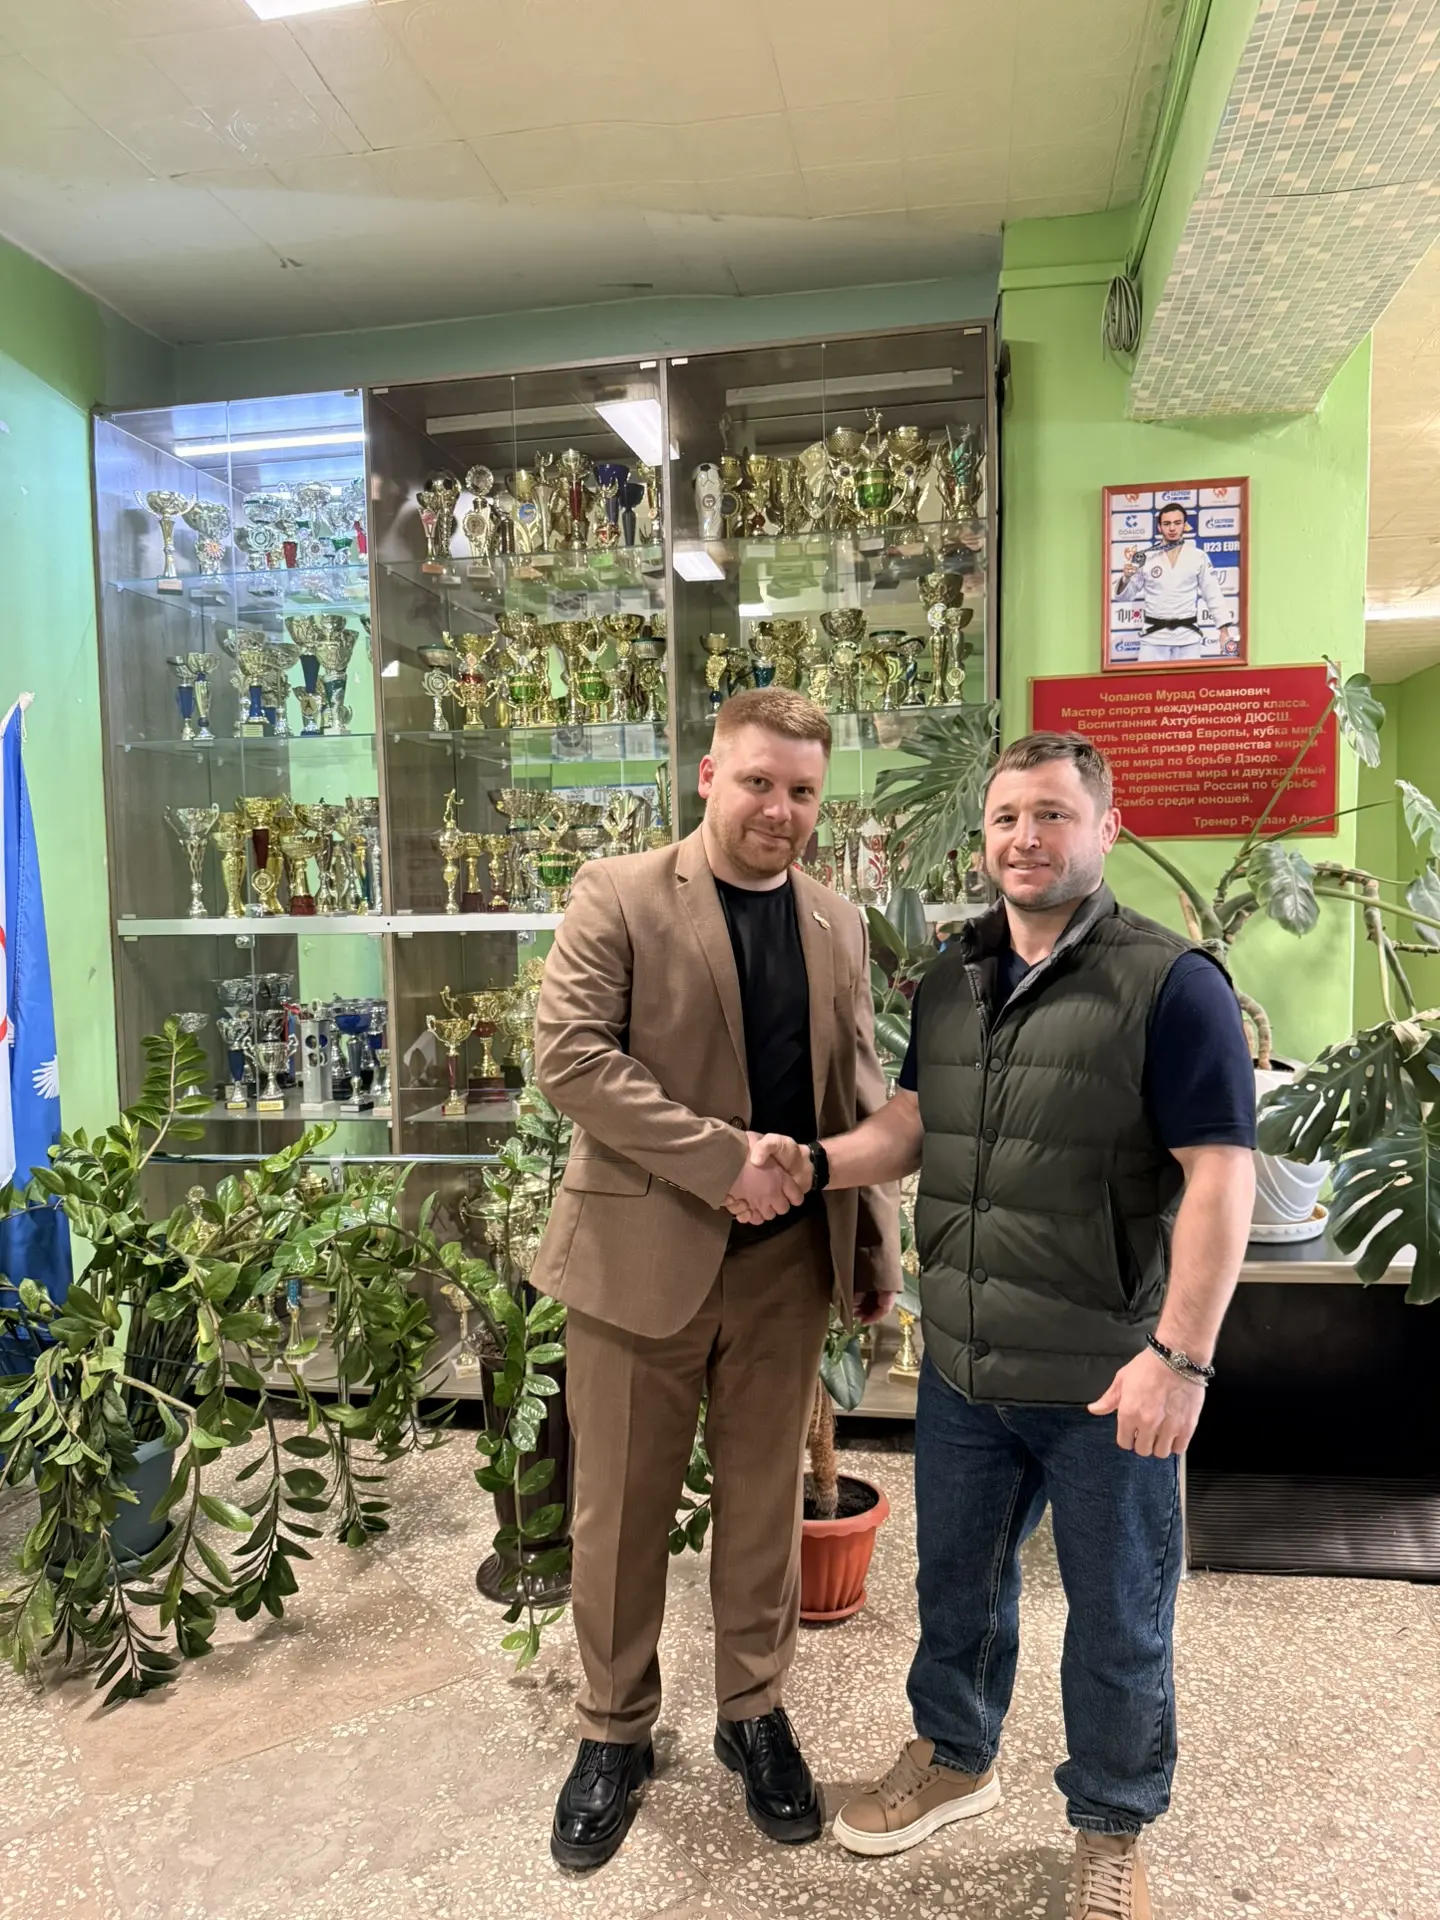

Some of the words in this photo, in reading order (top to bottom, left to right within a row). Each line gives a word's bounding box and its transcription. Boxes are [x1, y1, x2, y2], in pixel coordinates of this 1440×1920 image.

[1100, 692, 1153, 702] Чопанов
[1156, 689, 1196, 701] Мурад
[1199, 687, 1270, 698] Османович
[1061, 708, 1105, 718] Мастер
[1109, 705, 1151, 716] спорта
[1154, 702, 1260, 714] международного
[1264, 699, 1309, 710] класса.
[1078, 719, 1157, 730] Воспитанник
[1160, 714, 1242, 728] Ахтубинской
[1121, 731, 1193, 743] первенства
[1196, 728, 1250, 739] Европы,
[1253, 725, 1288, 738] кубка
[1152, 743, 1195, 754] призер
[1199, 740, 1271, 753] первенства
[1133, 758, 1163, 768] мира
[1168, 757, 1182, 766] по
[1186, 755, 1231, 767] борьбе
[1235, 753, 1280, 765] Дзюдо.
[1121, 770, 1193, 783] первенства
[1196, 769, 1228, 779] мира
[1231, 769, 1239, 777] и
[1242, 765, 1326, 778] двухкртный
[1129, 783, 1200, 795] первенства
[1203, 781, 1248, 791] России
[1252, 781, 1267, 790] по
[1271, 778, 1317, 791] брьбе
[1114, 796, 1154, 807] Самбо
[1157, 796, 1195, 807] среди
[1198, 793, 1253, 804] юношей.
[1194, 816, 1238, 828] Тренер
[1241, 815, 1286, 827] Рулан
